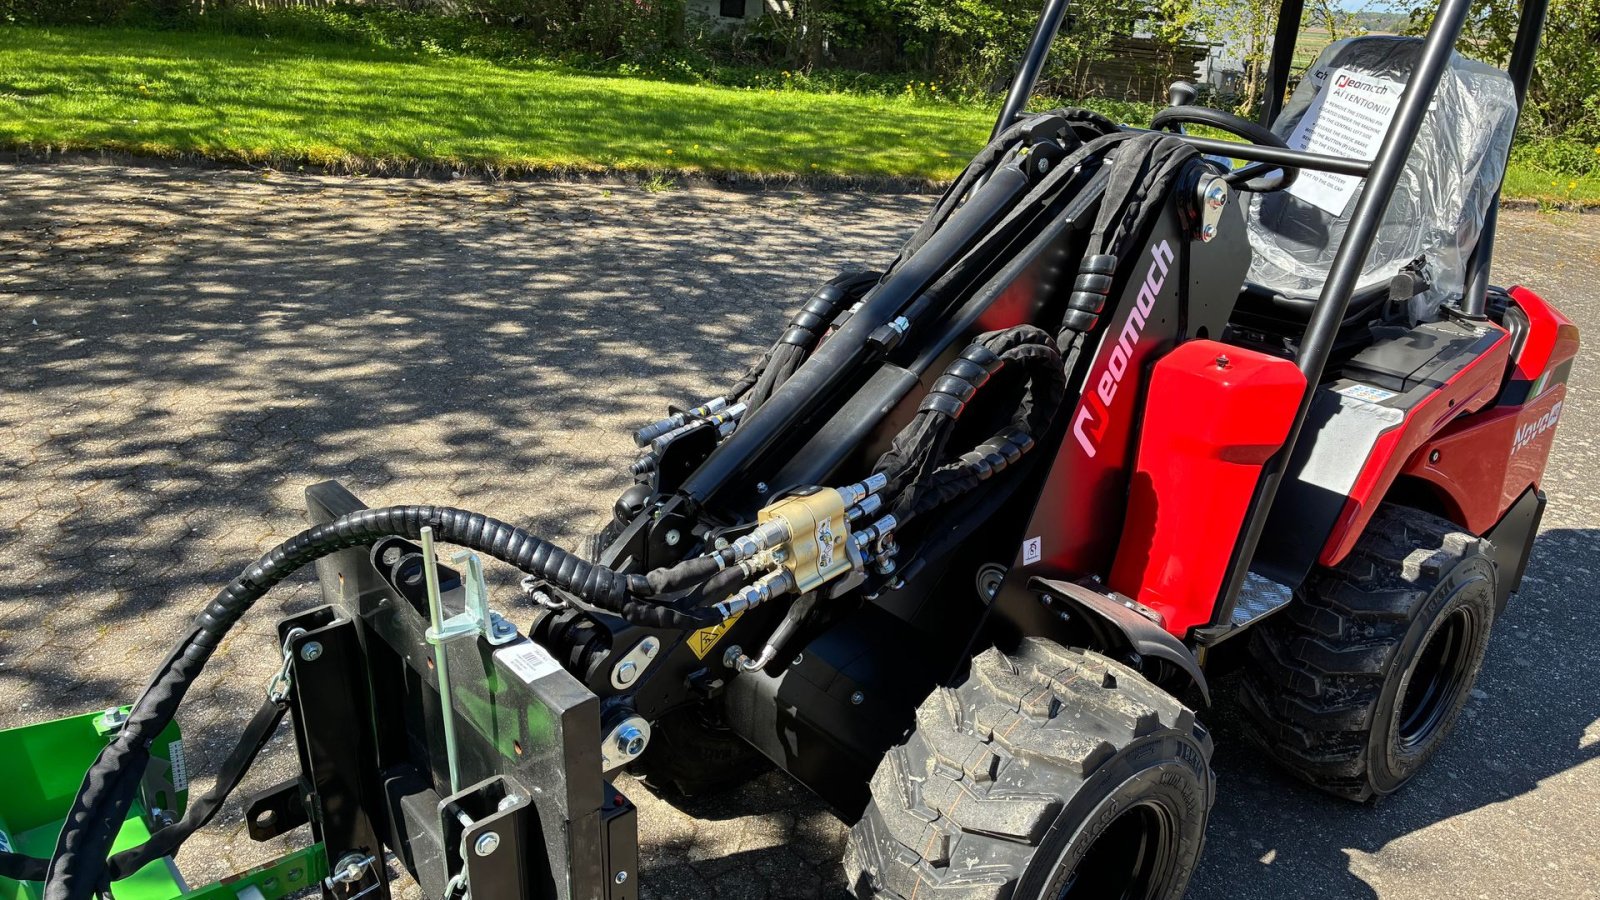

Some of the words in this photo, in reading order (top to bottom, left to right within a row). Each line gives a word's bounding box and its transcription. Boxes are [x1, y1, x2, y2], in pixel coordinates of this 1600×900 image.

[1329, 102, 1347, 112] REMOVE
[1355, 112, 1375, 124] STEERING
[1333, 89, 1390, 116] ATTENTION!!!
[1319, 106, 1338, 117] LOCATED
[1338, 114, 1352, 123] UNDER
[1361, 124, 1380, 135] MACHINE
[1335, 121, 1353, 132] CENTRAL
[1302, 135, 1318, 144] BEHND
[1325, 136, 1342, 146] BUTTON
[1348, 146, 1367, 157] LOCATED
[1341, 134, 1354, 142] STATIC
[1354, 140, 1368, 148] BRAKE
[1328, 175, 1346, 185] BATTERY
[1073, 239, 1175, 458] Neomach
[1511, 412, 1549, 455] Nova
